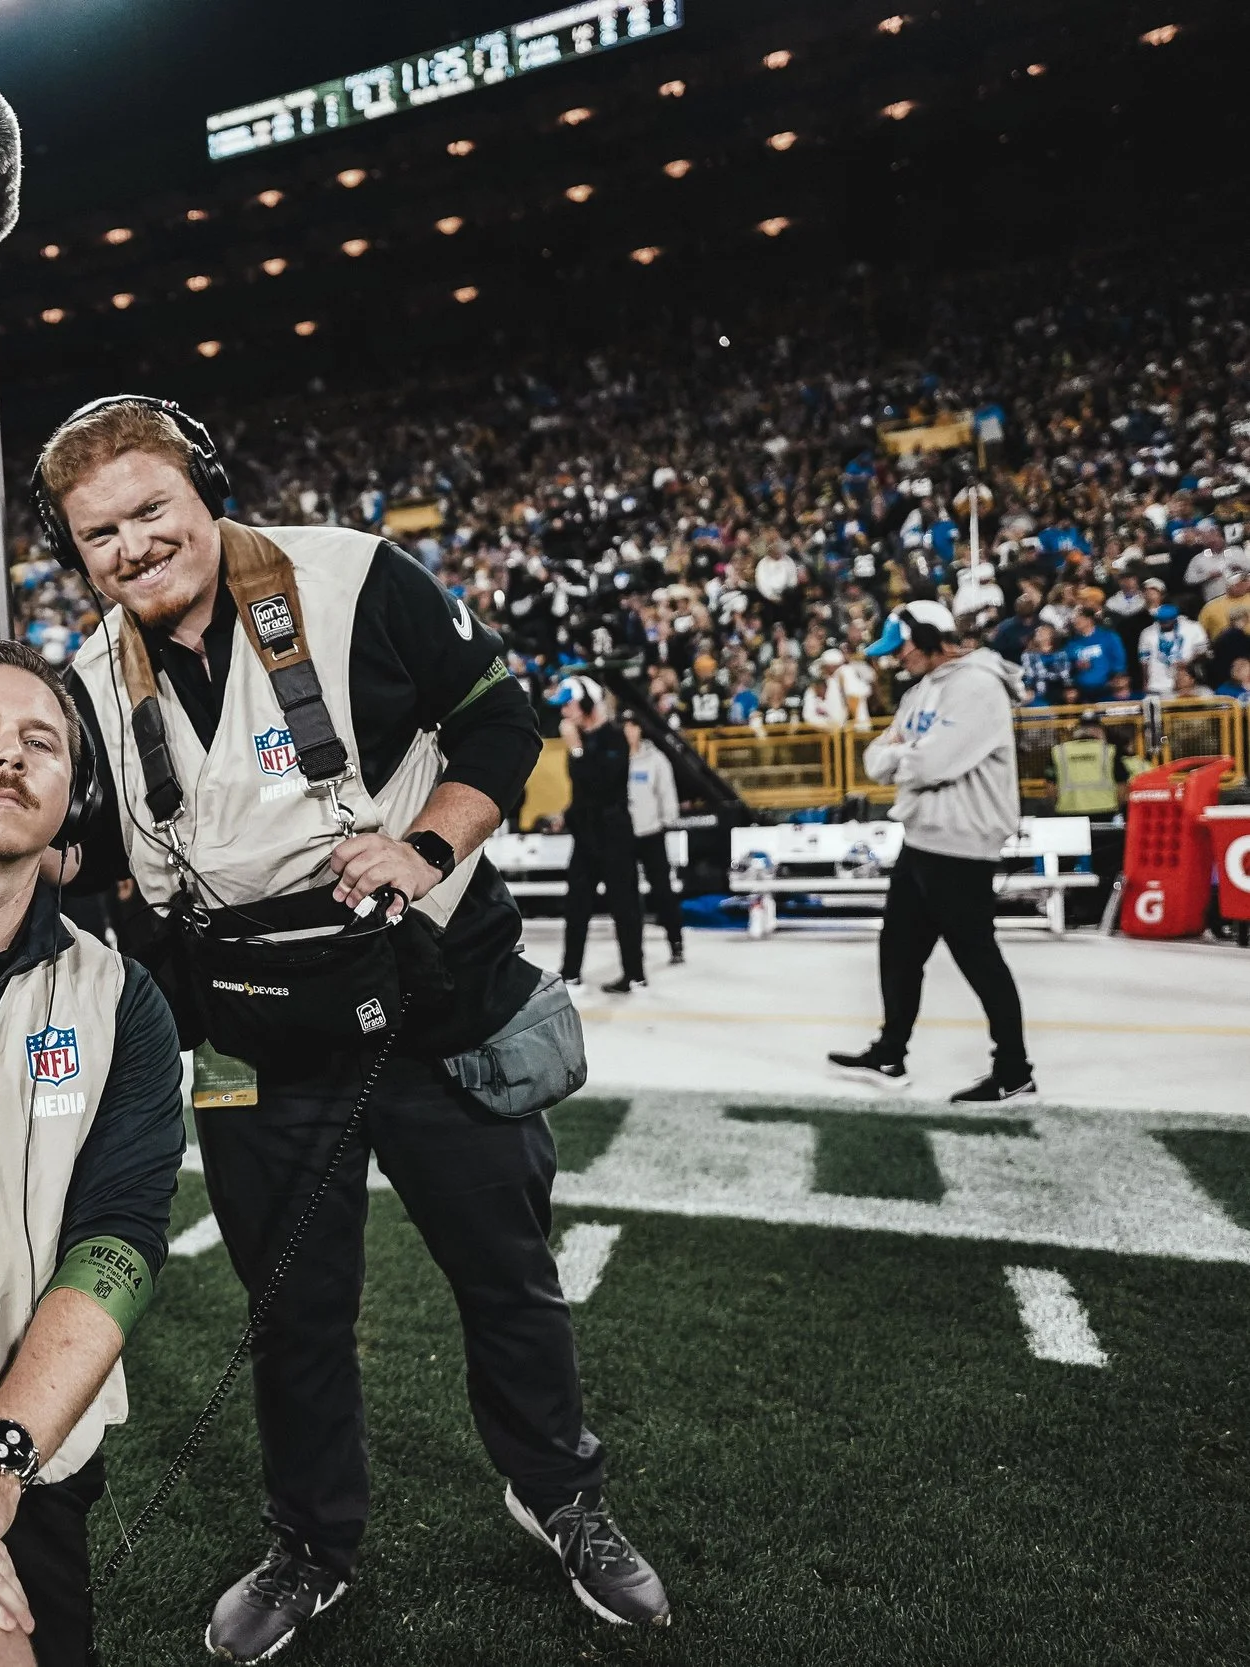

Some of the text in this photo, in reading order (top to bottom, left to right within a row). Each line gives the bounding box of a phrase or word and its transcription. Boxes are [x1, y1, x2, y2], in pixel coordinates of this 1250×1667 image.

[256, 602, 287, 622] porta
[260, 615, 291, 633] brace
[260, 745, 300, 771] NFL
[212, 979, 290, 996] SOUND DEVICES
[361, 1004, 381, 1021] porta
[364, 1015, 384, 1029] brace
[33, 1048, 76, 1079] NFL
[29, 1092, 86, 1119] MEDIA
[121, 1245, 132, 1256] GB
[90, 1246, 137, 1280] WEEK
[133, 1277, 142, 1289] 4
